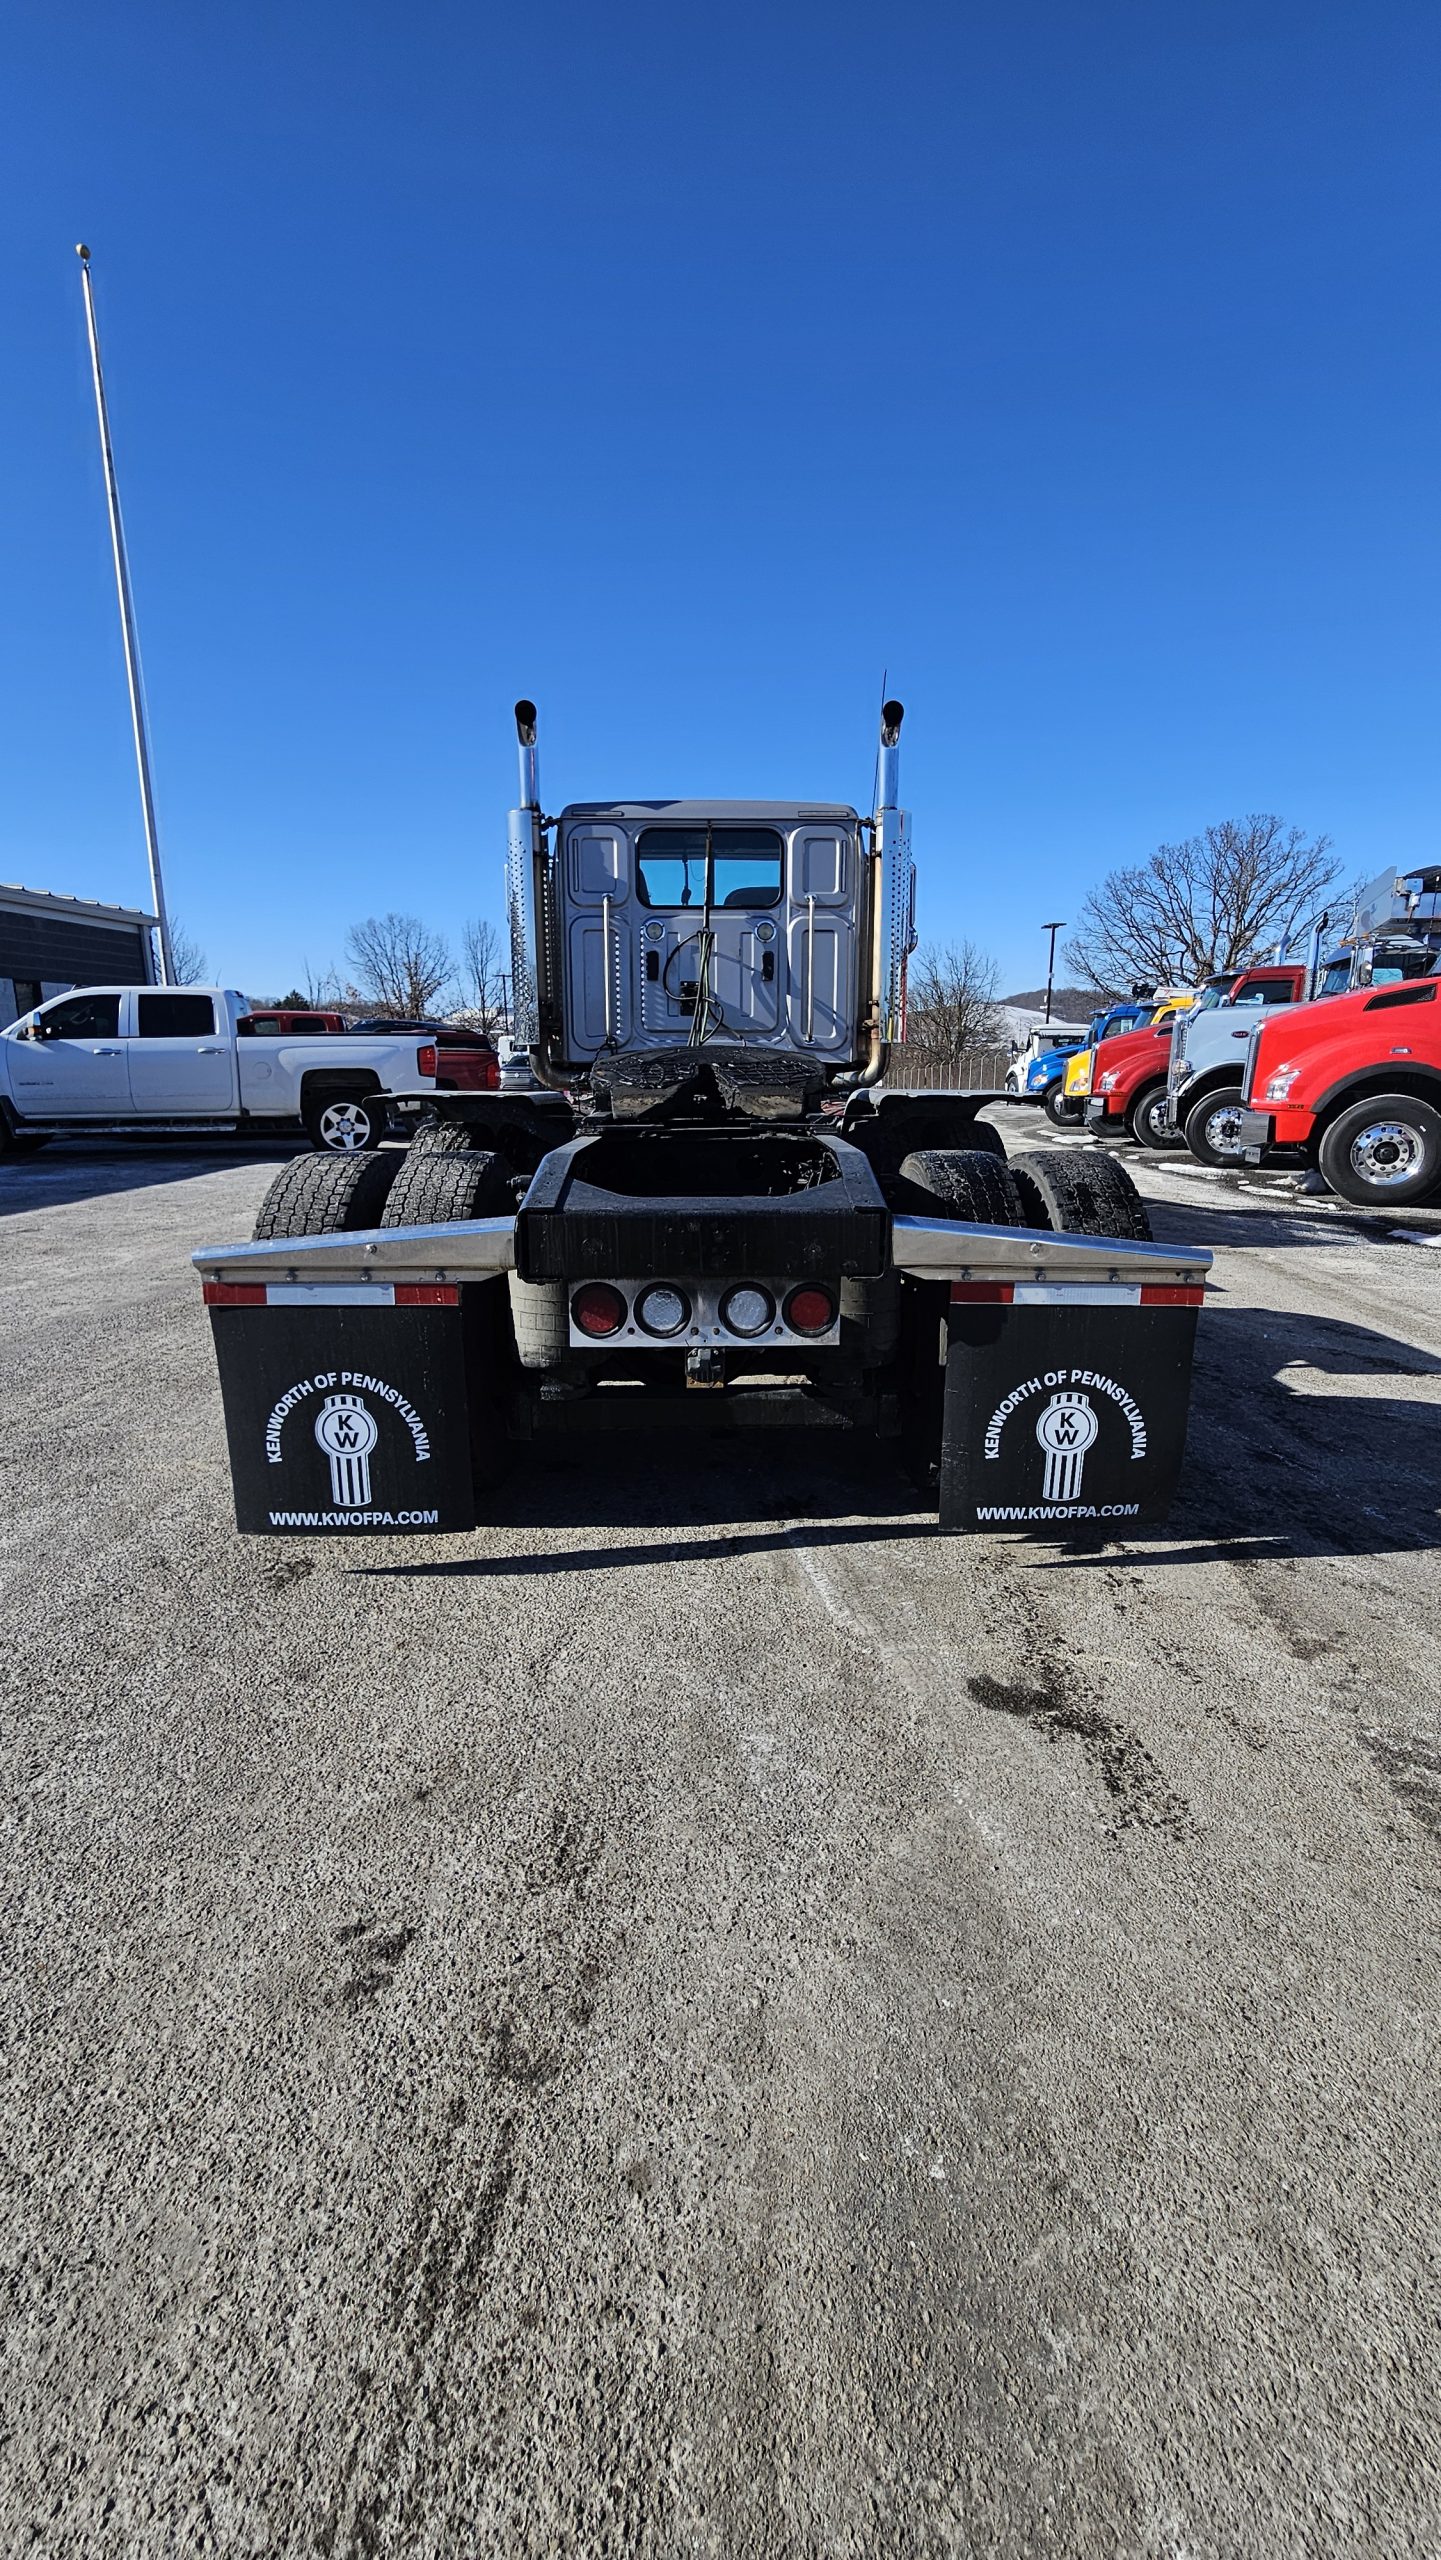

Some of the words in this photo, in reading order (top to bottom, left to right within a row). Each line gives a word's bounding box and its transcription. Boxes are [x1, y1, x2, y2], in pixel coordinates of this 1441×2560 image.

[266, 1380, 314, 1464] KENWORTH
[314, 1372, 338, 1389] OF
[341, 1371, 431, 1463] PENNSYLVANIA
[337, 1414, 353, 1431] K
[984, 1377, 1042, 1460] KENWORTH
[1044, 1369, 1067, 1387] OF
[1070, 1369, 1147, 1460] PENNSYLVANIA
[1059, 1412, 1076, 1429] K
[333, 1432, 360, 1449] W
[1054, 1429, 1080, 1446] W
[269, 1509, 439, 1526] WWW.KWOFPA.COM
[976, 1503, 1140, 1521] WWW.KWOFPA.COM
